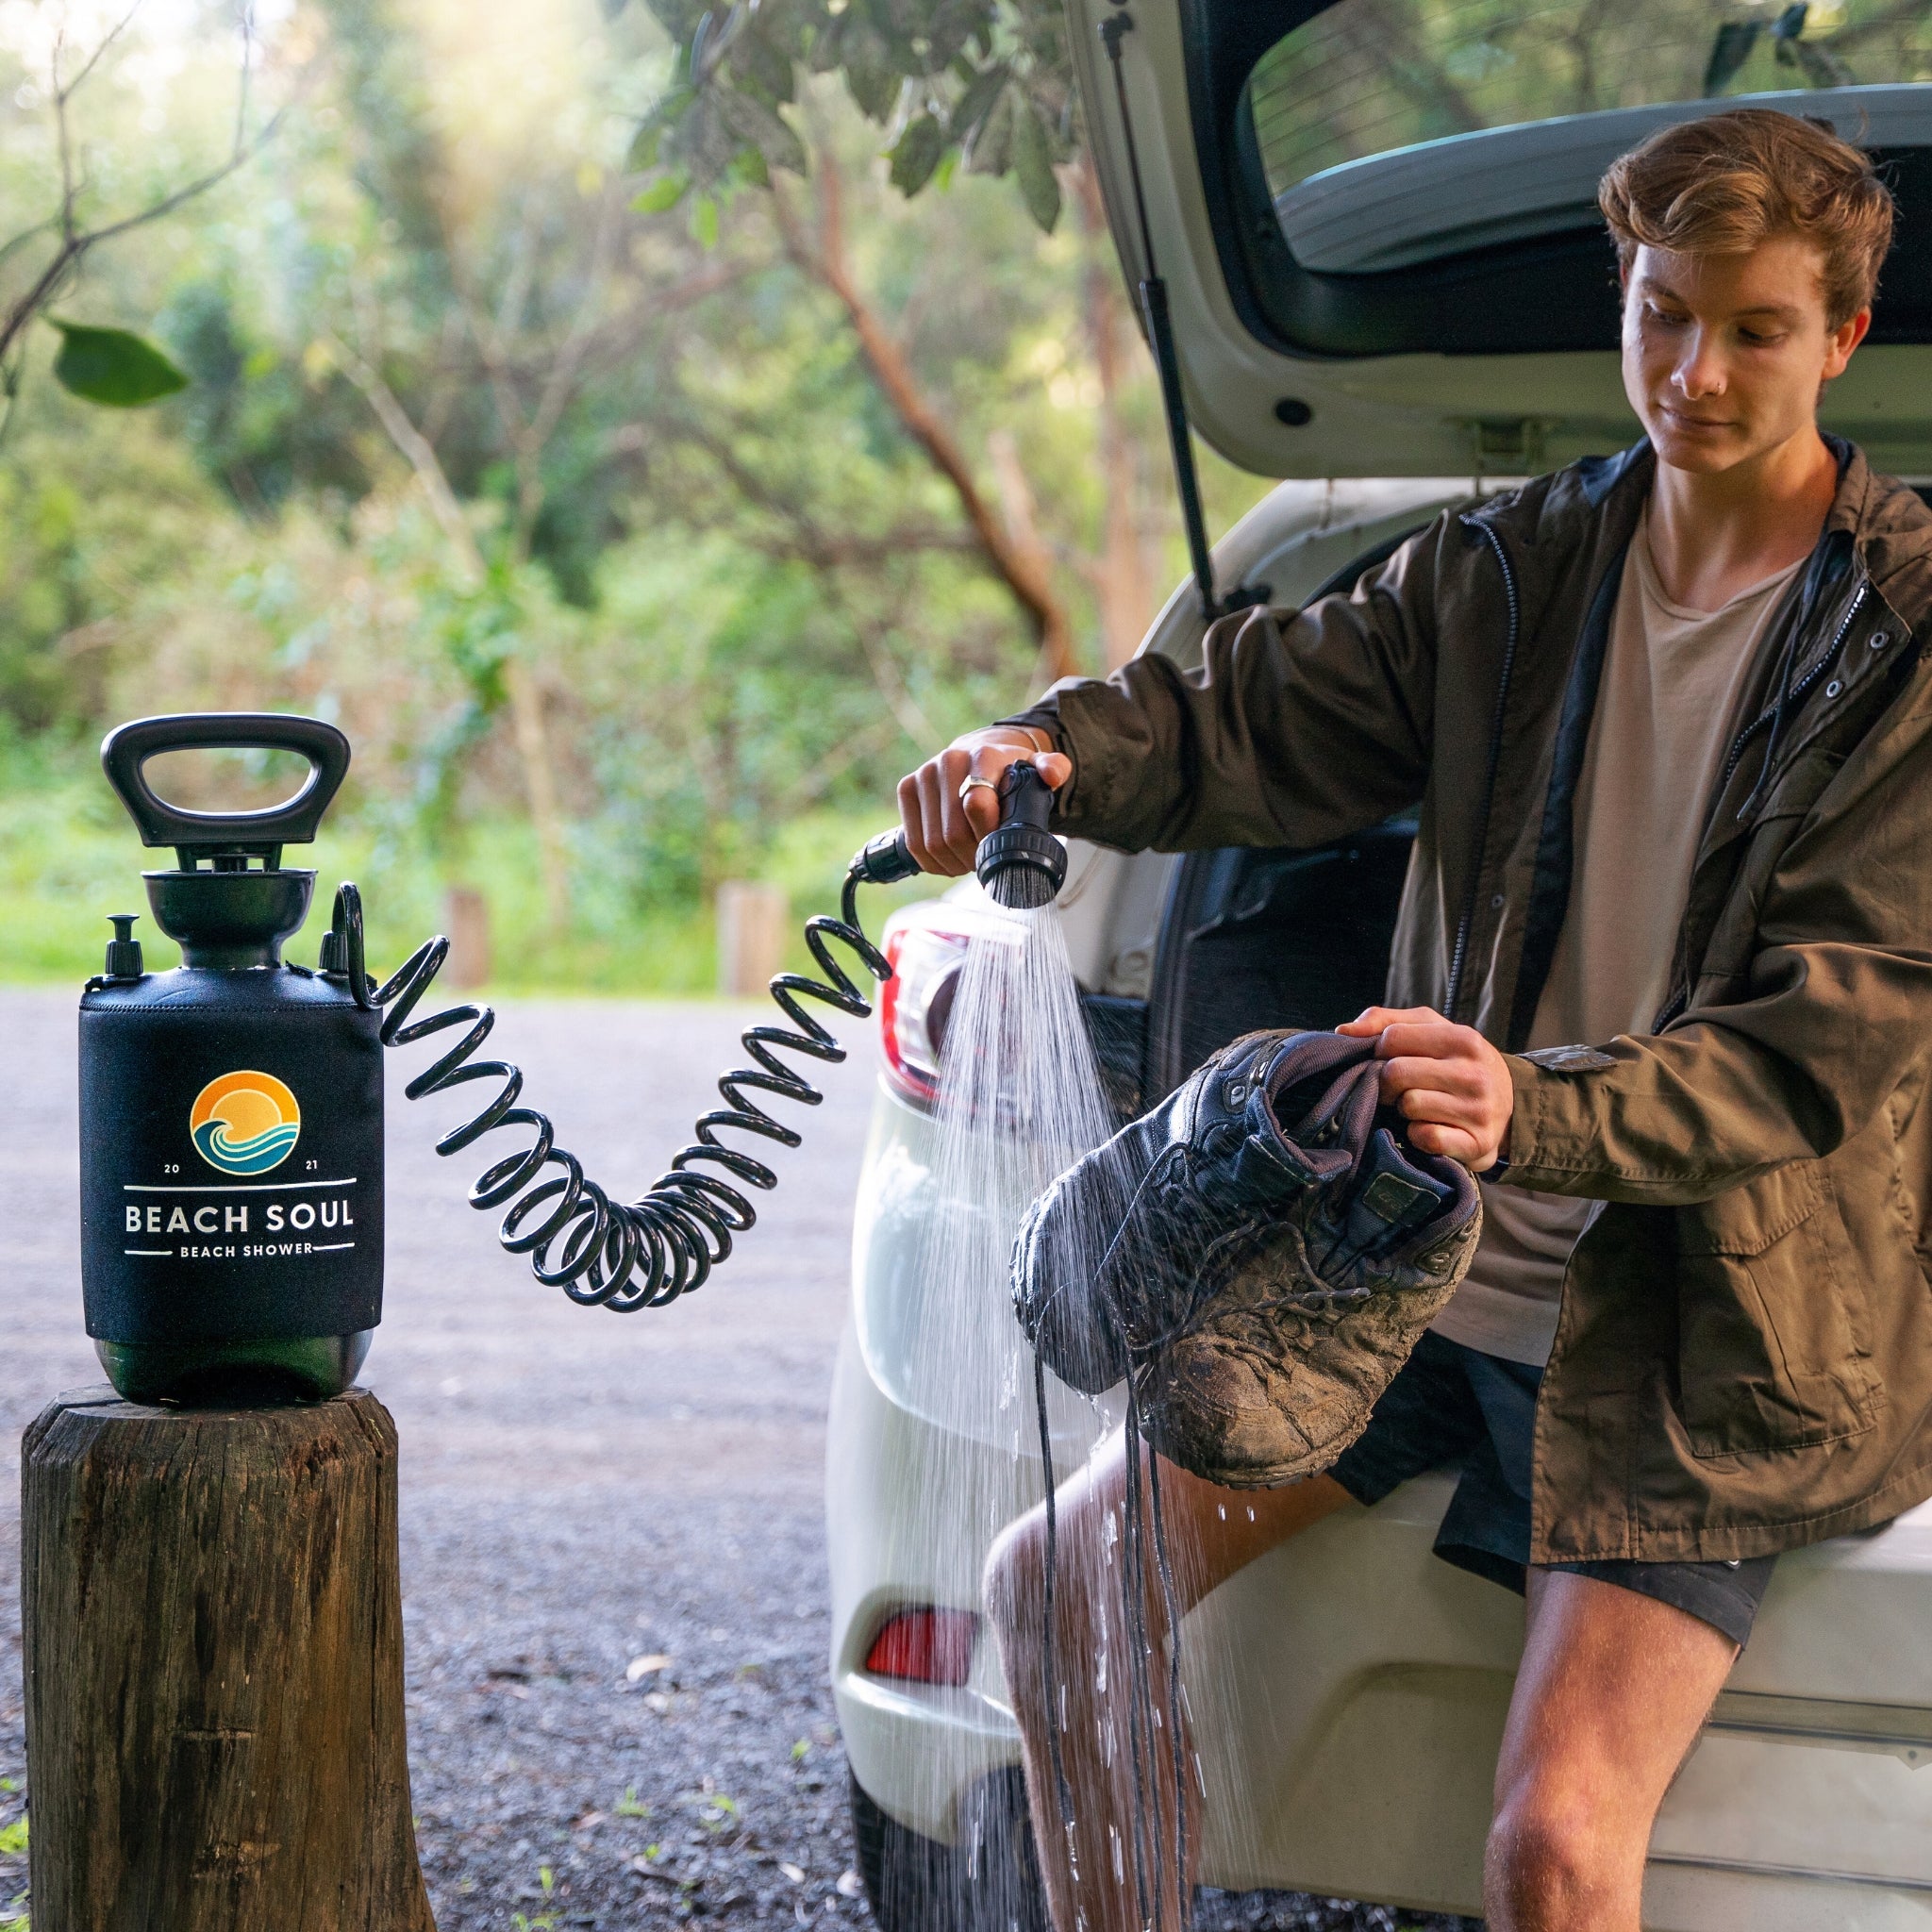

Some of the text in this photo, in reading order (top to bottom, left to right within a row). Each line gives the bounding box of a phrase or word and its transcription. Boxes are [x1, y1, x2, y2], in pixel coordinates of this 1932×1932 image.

[164, 1159, 318, 1174] 20 21
[125, 1199, 354, 1233] BEACH SOUL
[180, 1242, 313, 1257] BEACH SHOWER
